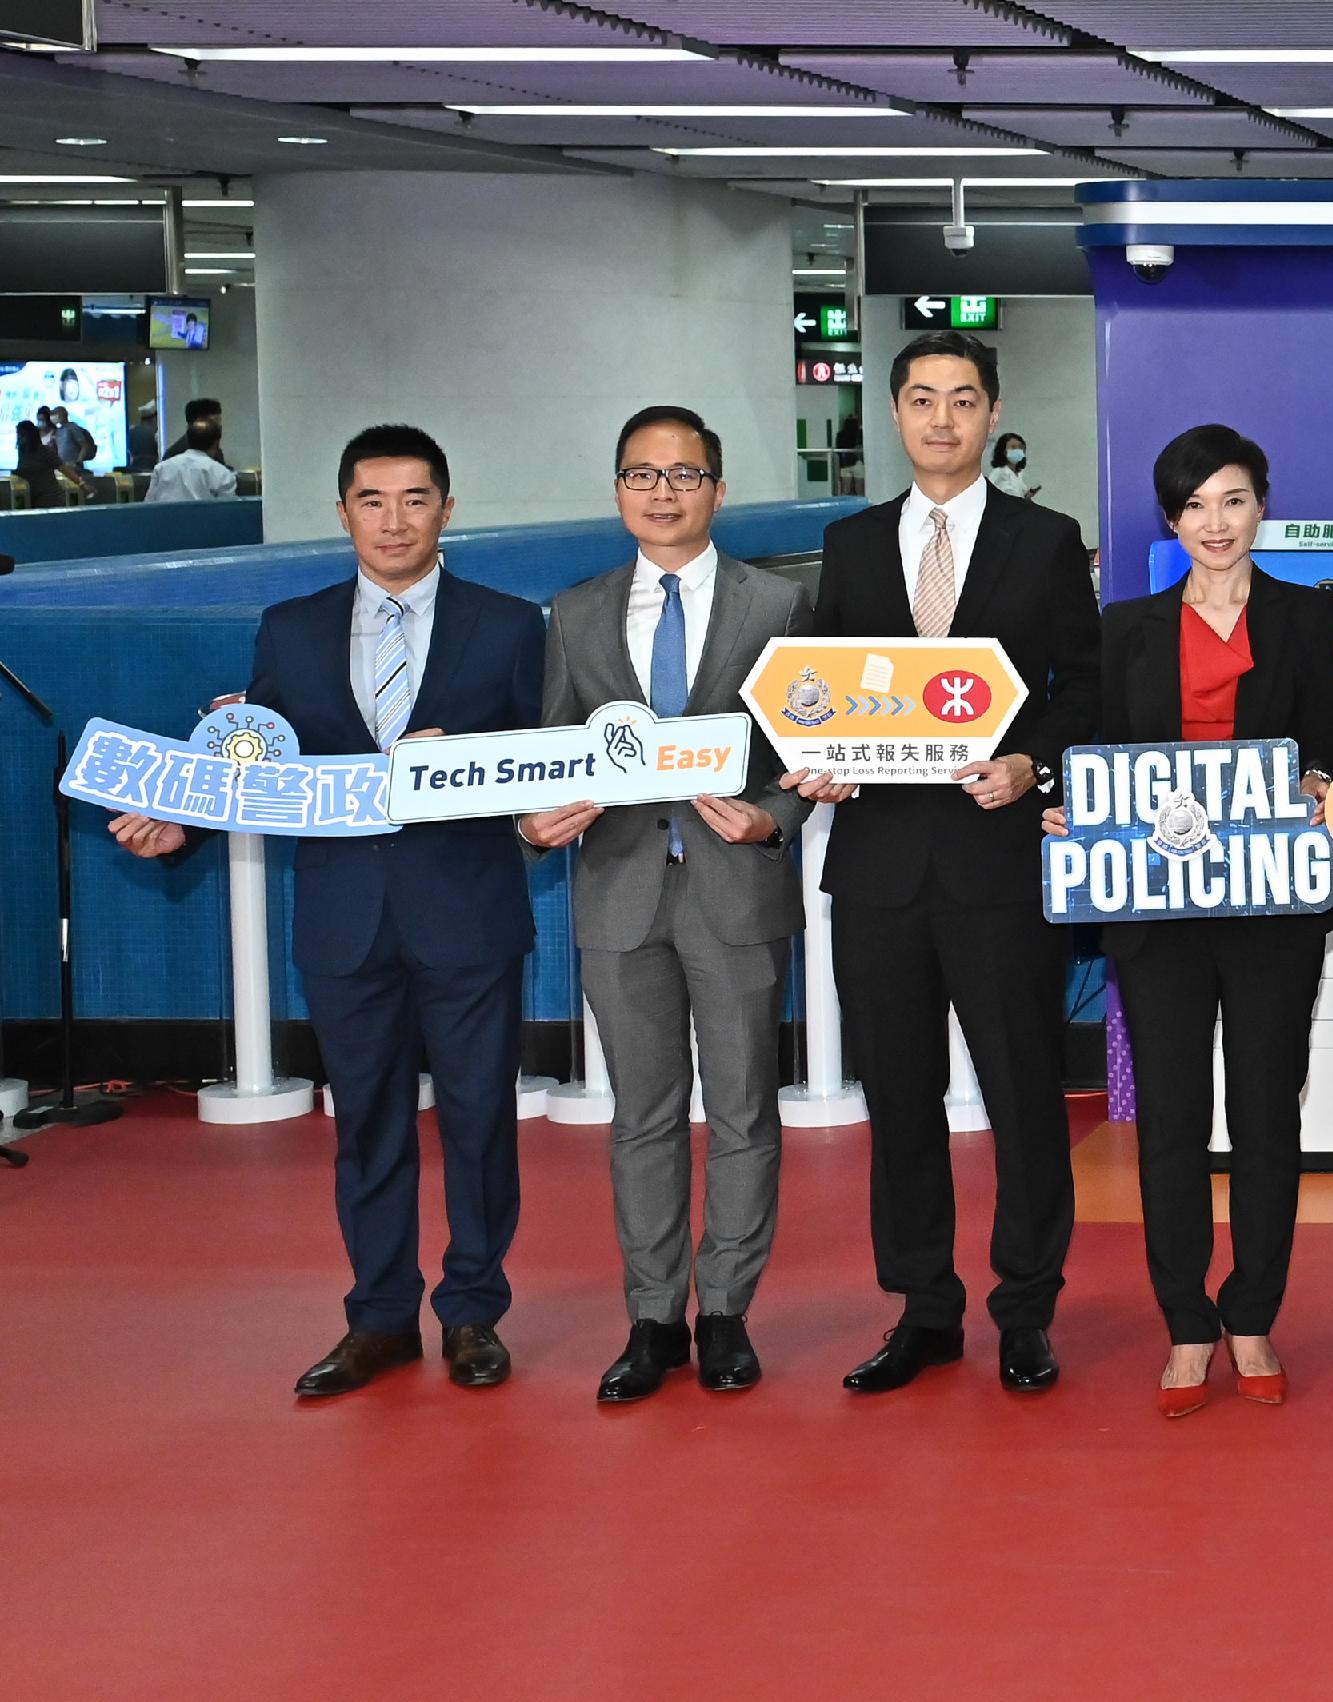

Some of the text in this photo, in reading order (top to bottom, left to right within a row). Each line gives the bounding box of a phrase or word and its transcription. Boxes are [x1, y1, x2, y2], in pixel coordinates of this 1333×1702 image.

[960, 313, 986, 322] EXIT
[409, 744, 733, 791] Tech Smart Easy
[801, 743, 969, 762] 一站式報失服務
[807, 765, 850, 776] ne-stop
[853, 766, 875, 775] Loss
[878, 766, 928, 777] Reporting
[67, 731, 393, 827] 數碼警政
[1070, 747, 1308, 826] DIGITAL
[1049, 832, 1332, 914] POLICING
